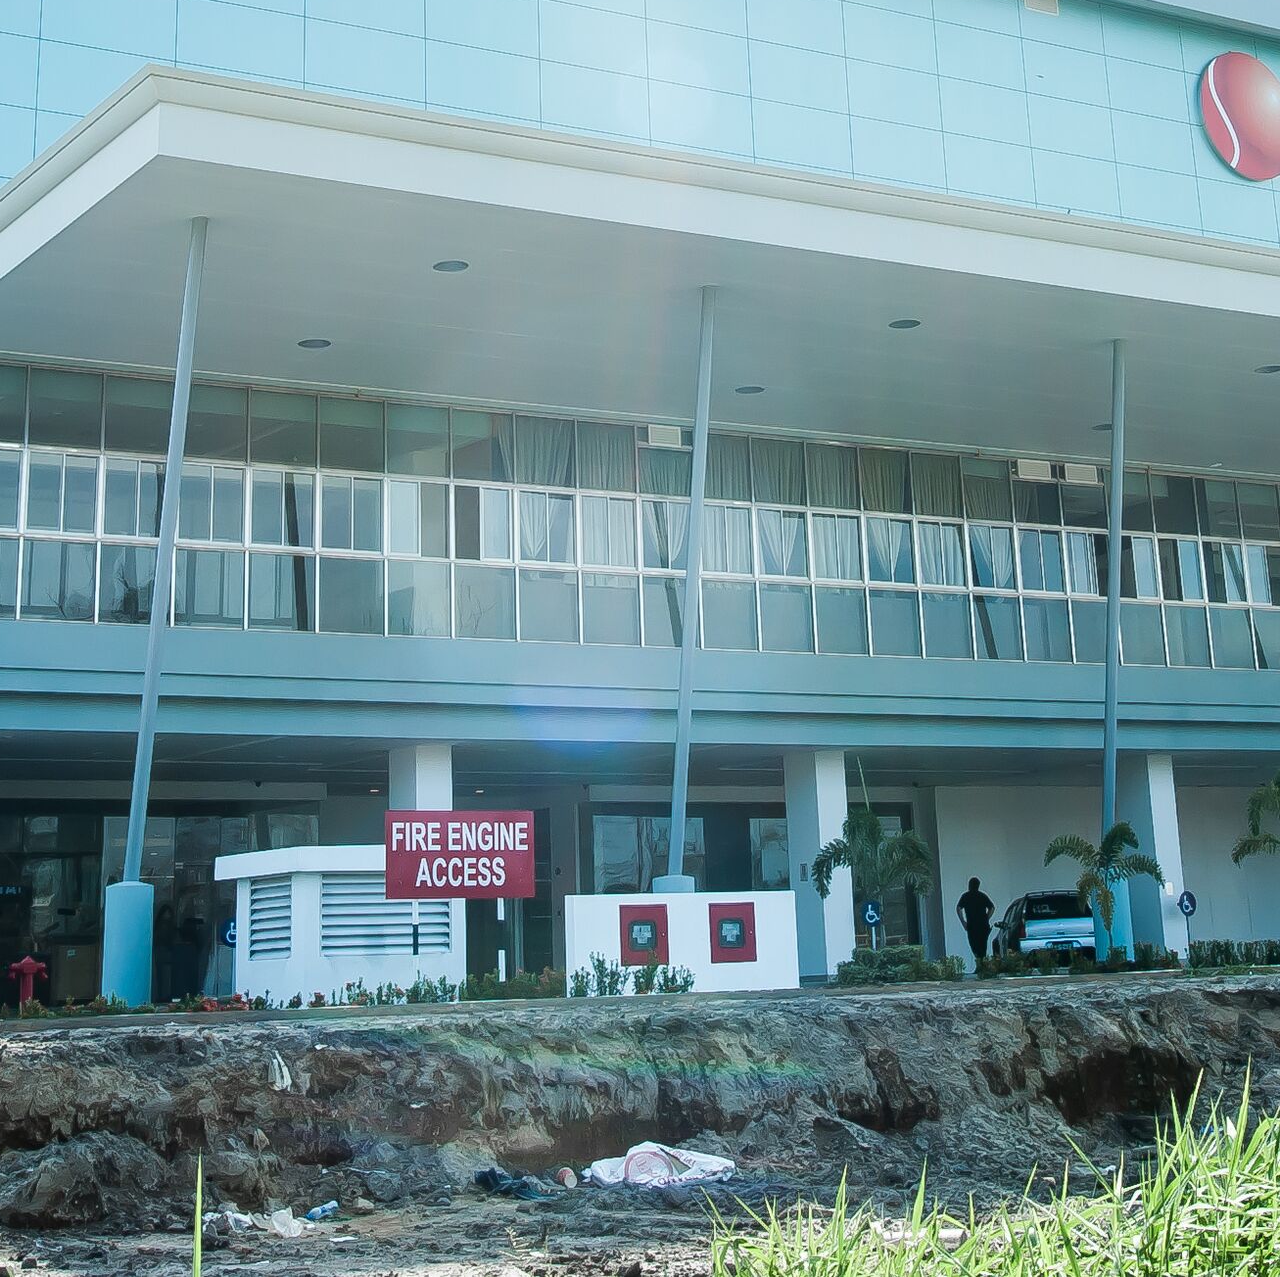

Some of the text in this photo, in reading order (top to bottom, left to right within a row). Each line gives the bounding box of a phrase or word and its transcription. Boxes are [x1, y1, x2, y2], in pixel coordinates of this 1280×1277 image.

[391, 821, 529, 852] FIRE ENGINE
[415, 857, 506, 887] ACCESS
